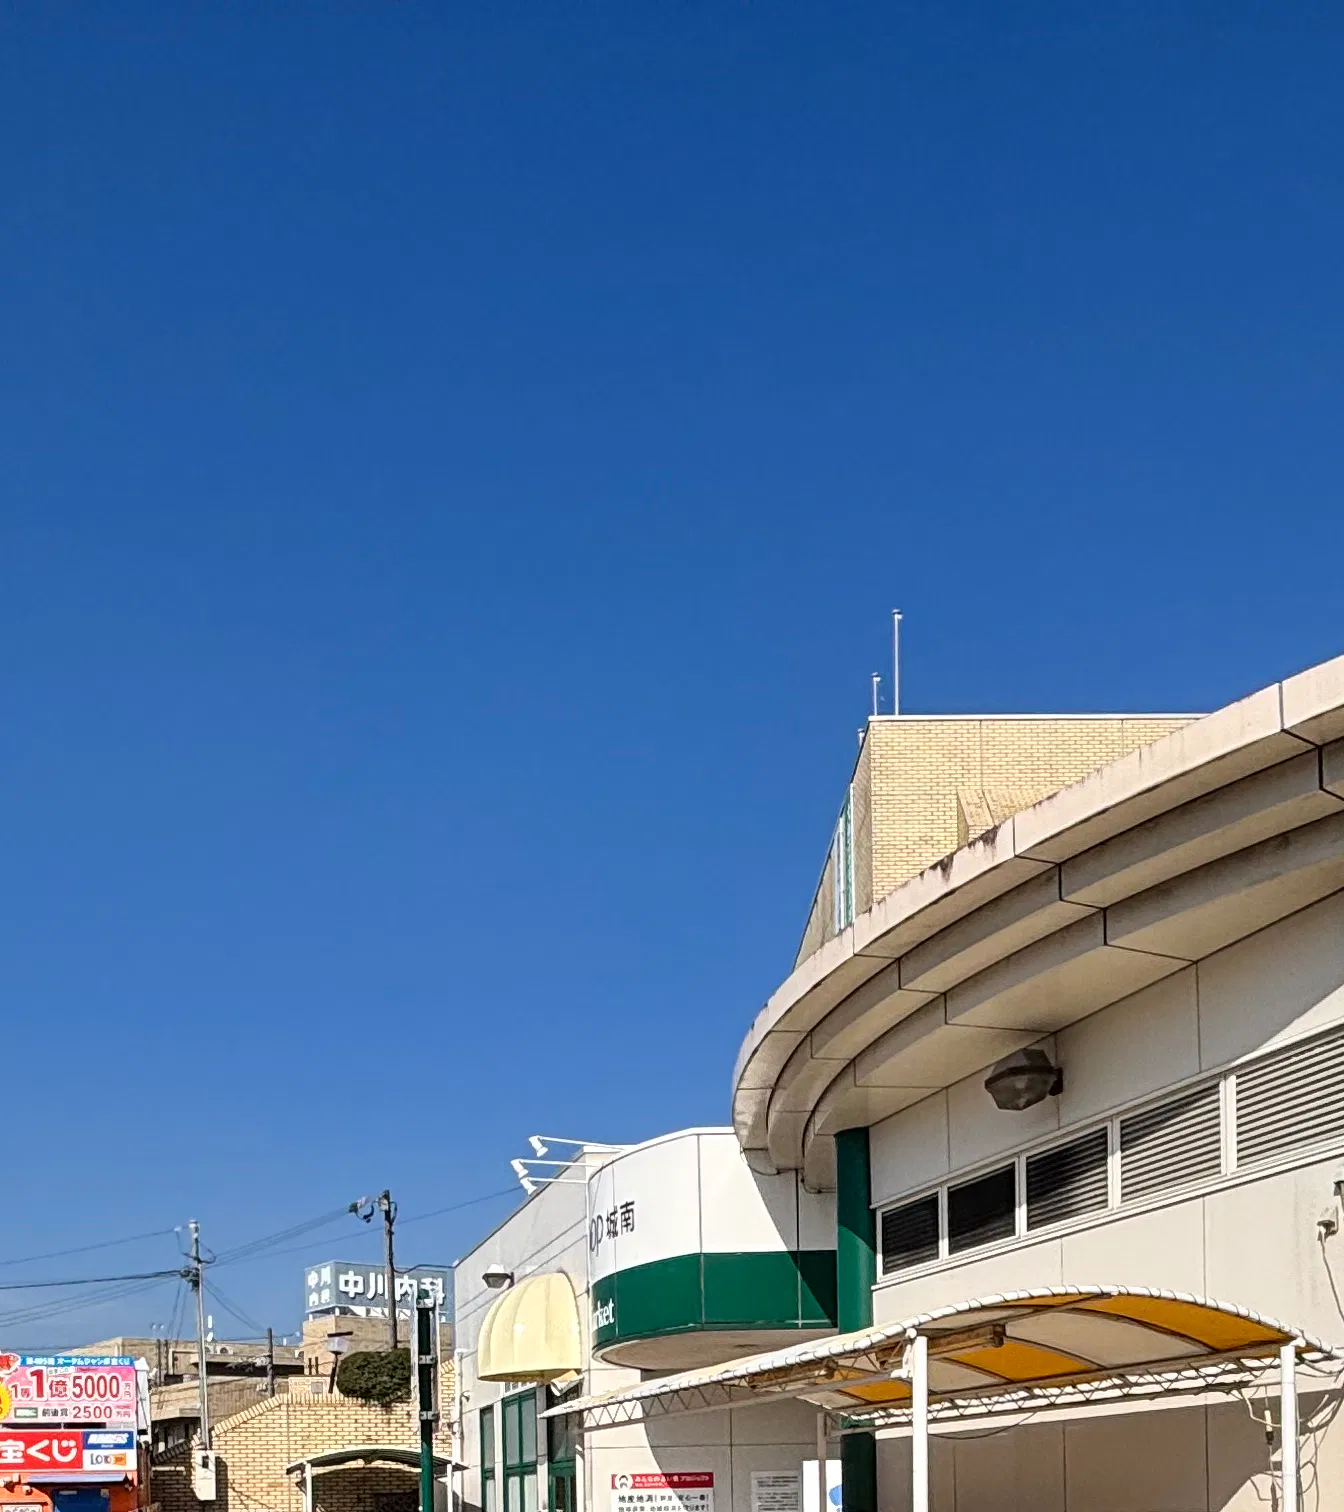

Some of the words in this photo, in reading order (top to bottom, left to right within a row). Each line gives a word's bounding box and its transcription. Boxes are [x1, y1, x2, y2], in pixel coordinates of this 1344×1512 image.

[606, 1200, 635, 1239] 城南
[339, 1270, 445, 1305] 中川内科
